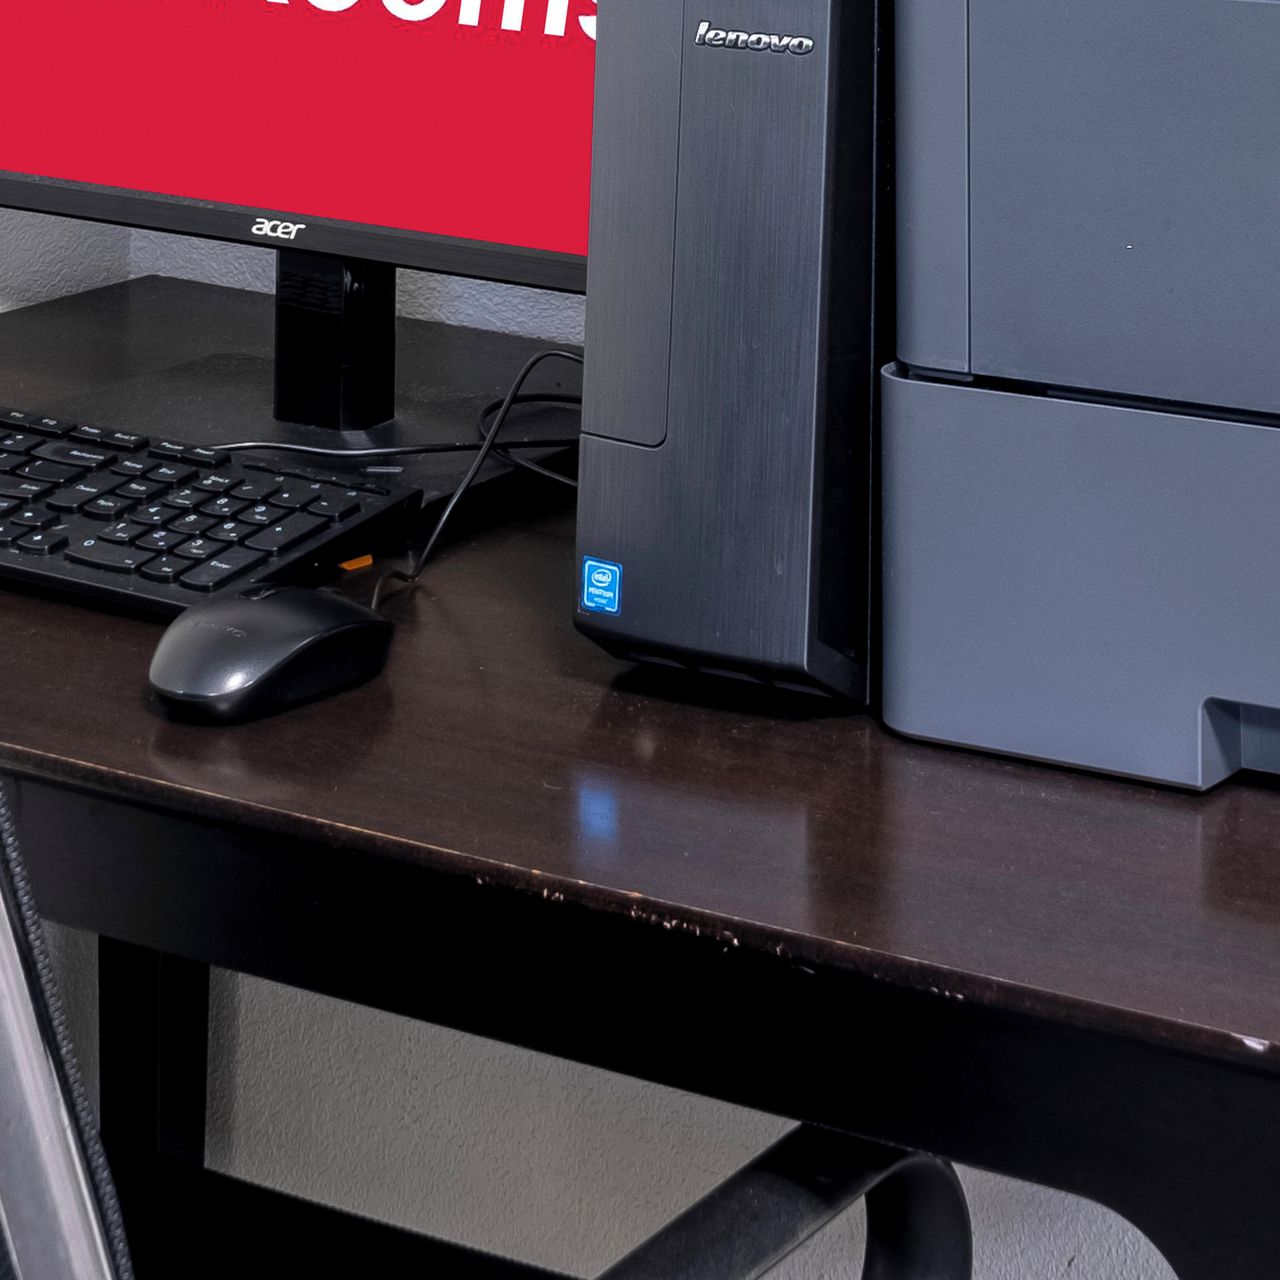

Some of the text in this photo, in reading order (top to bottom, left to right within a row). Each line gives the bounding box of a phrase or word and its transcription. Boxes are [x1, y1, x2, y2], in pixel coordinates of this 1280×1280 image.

[695, 21, 814, 55] lenovo
[251, 218, 307, 240] acer
[209, 560, 232, 569] Enter
